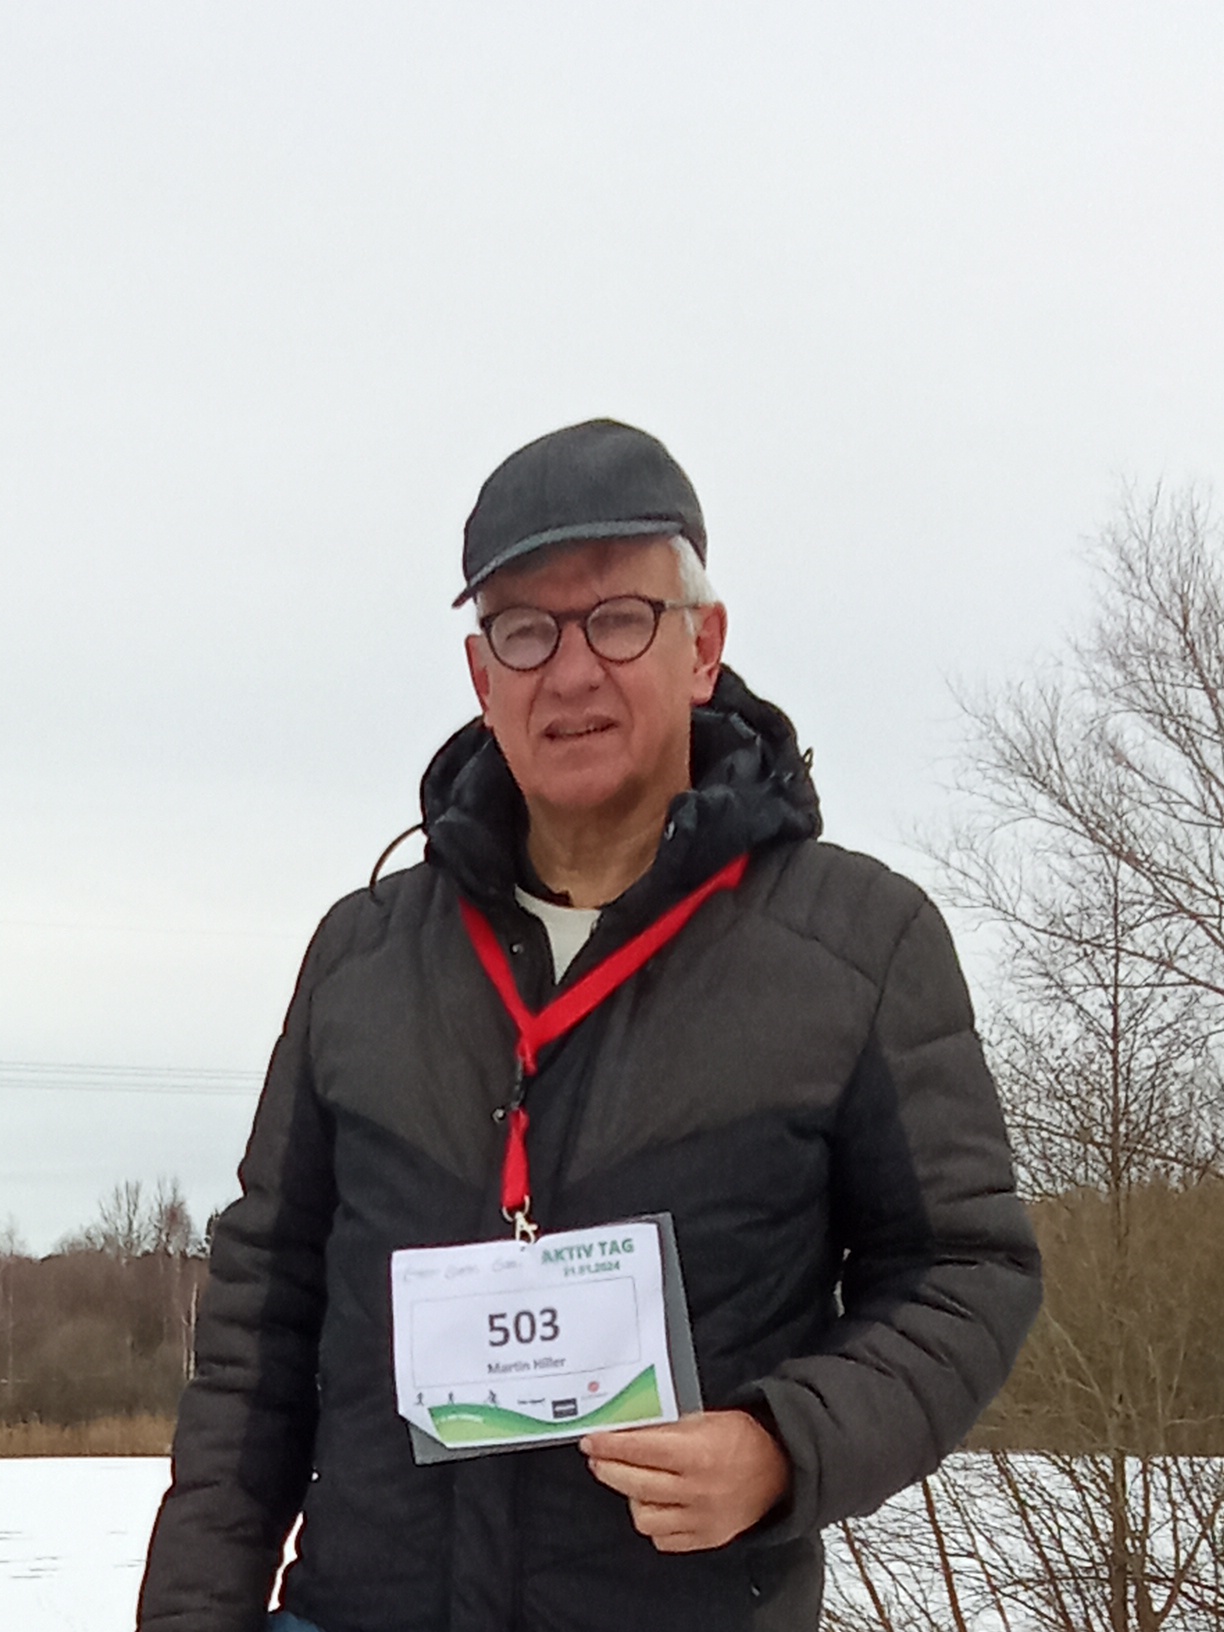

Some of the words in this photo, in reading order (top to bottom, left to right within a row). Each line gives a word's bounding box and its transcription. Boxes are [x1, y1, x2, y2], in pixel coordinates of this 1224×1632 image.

[541, 1243, 594, 1264] AKTIV
[599, 1238, 634, 1256] TAG
[488, 1306, 560, 1347] 503
[487, 1360, 530, 1374] Martin
